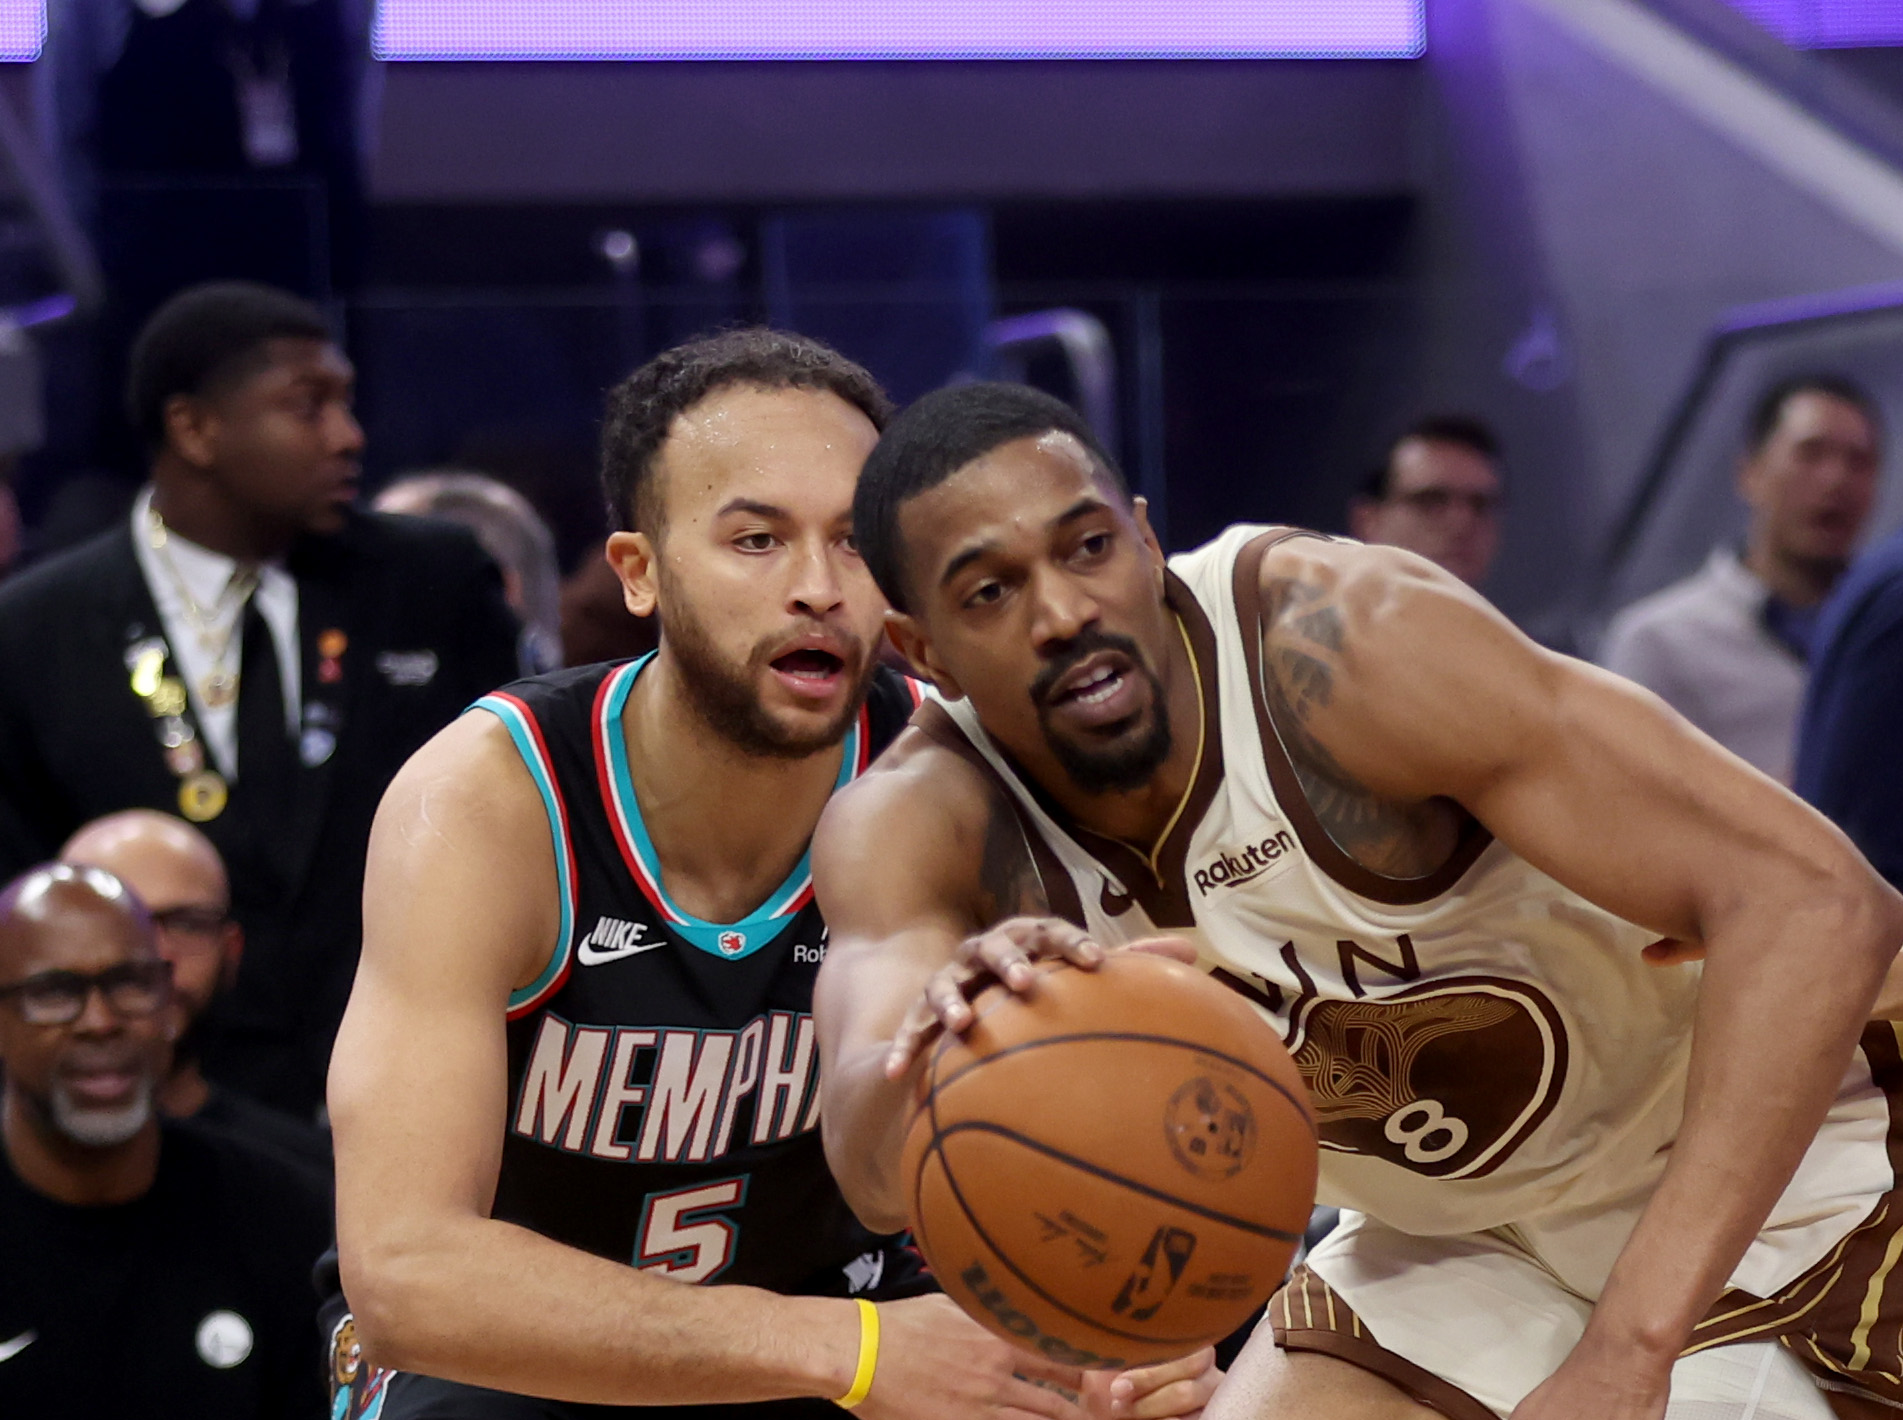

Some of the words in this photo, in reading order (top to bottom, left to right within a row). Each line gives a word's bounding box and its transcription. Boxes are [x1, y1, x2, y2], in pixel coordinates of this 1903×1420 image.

[1194, 829, 1296, 896] Rakuten
[591, 916, 648, 949] NIKE
[1385, 1100, 1469, 1163] 8
[631, 1172, 752, 1285] 5
